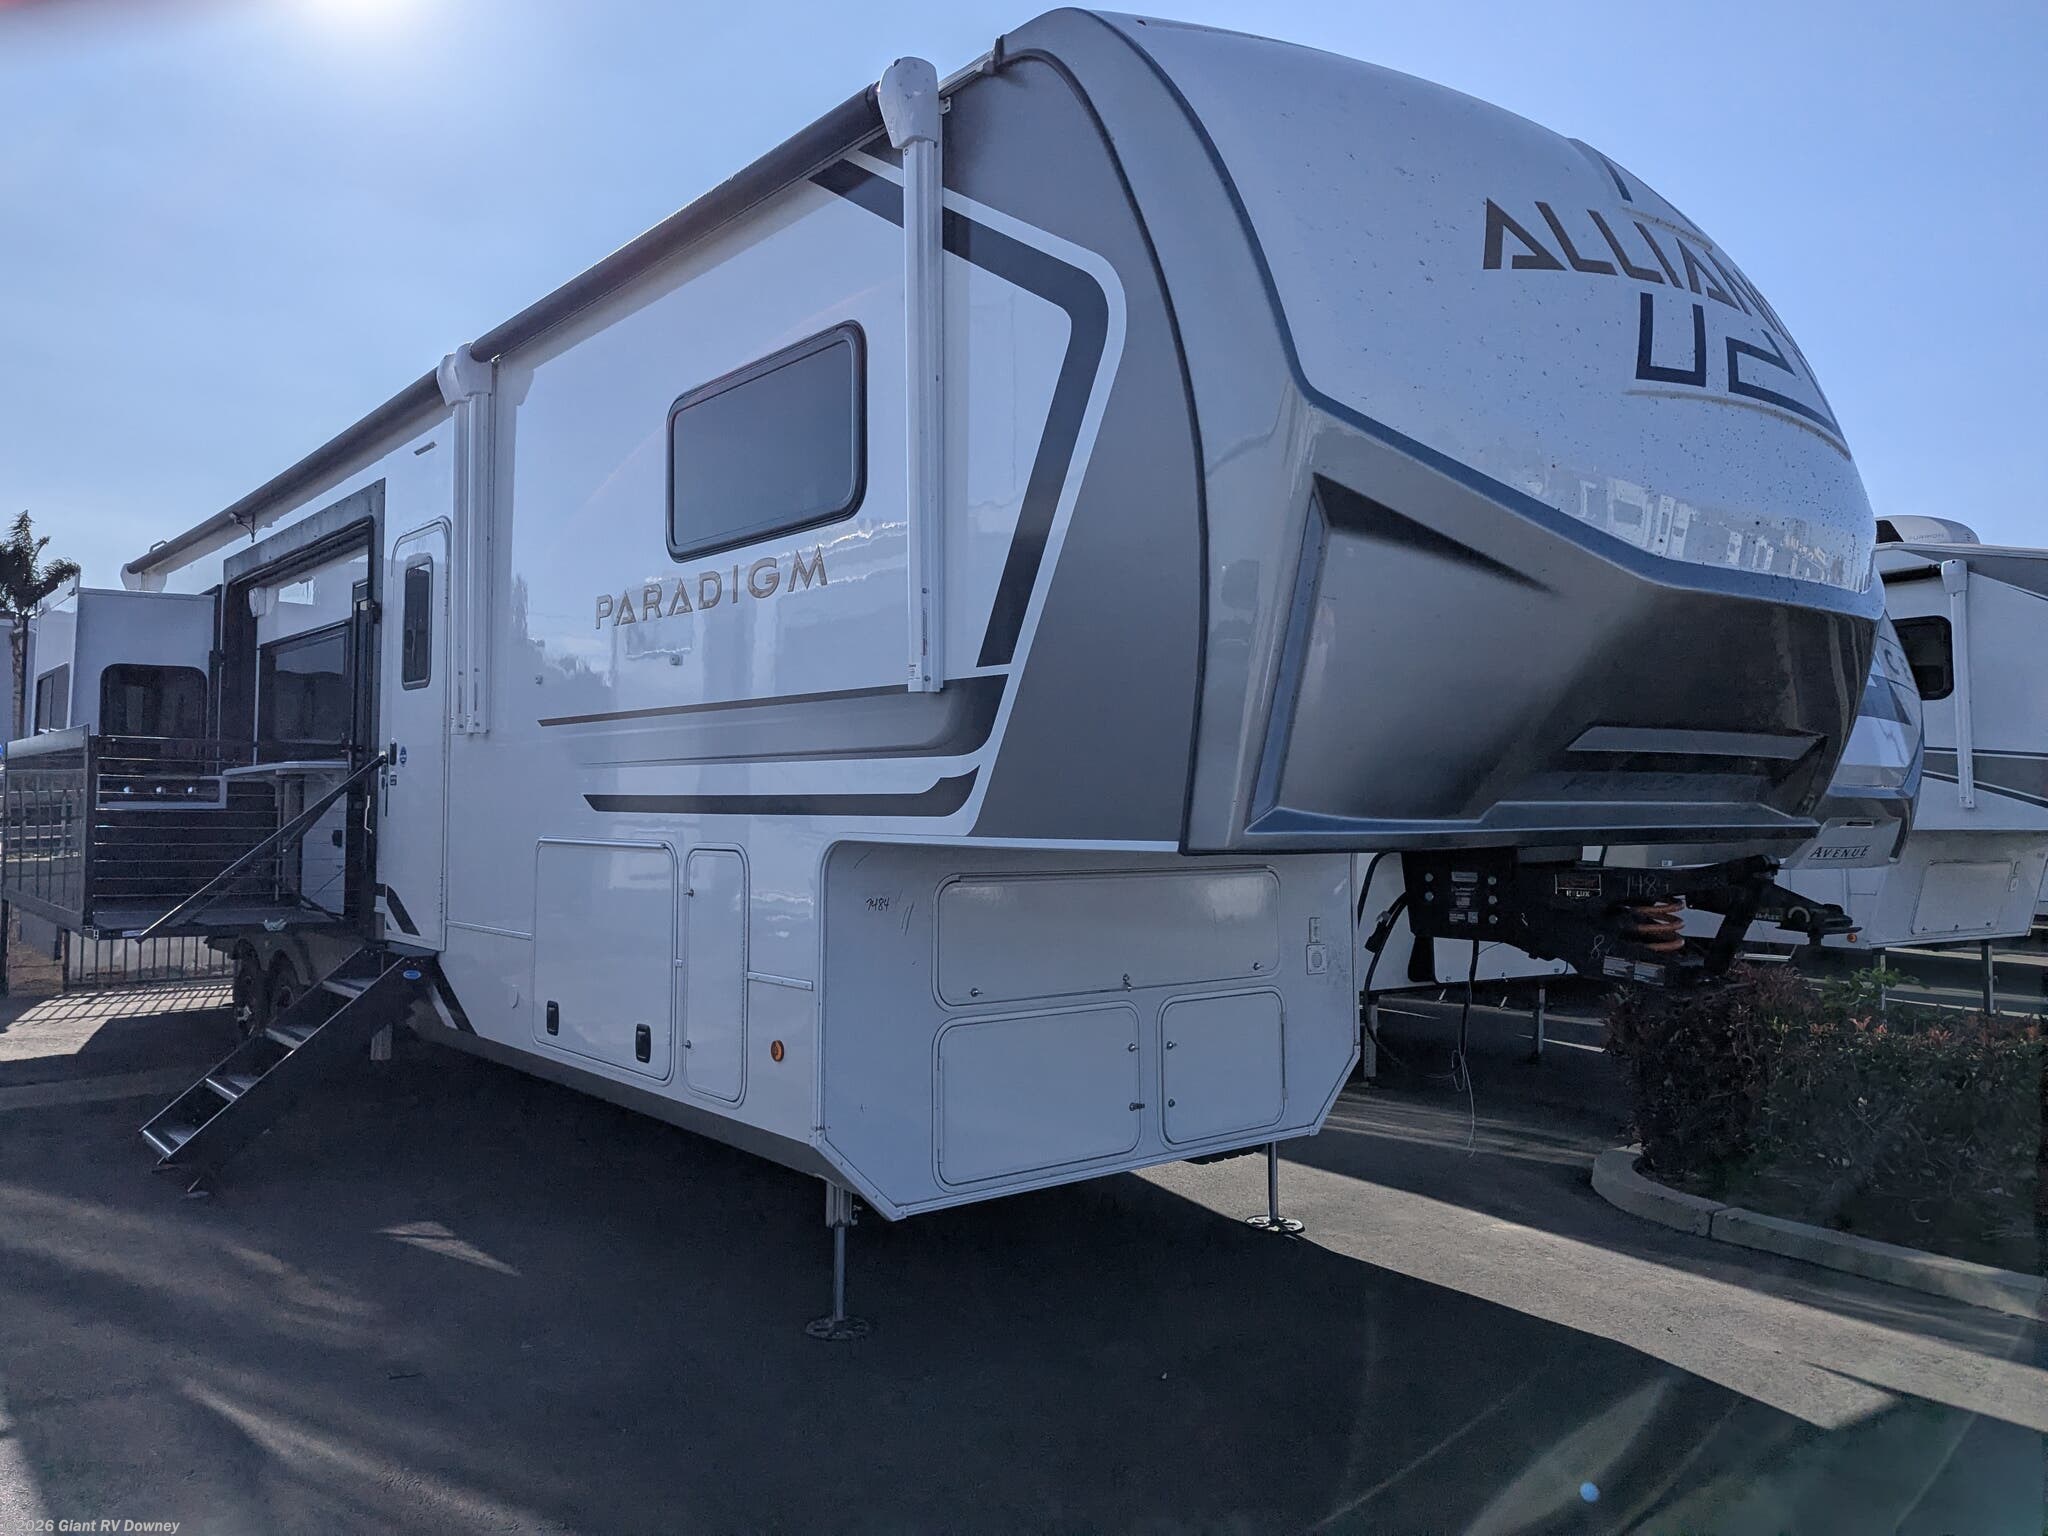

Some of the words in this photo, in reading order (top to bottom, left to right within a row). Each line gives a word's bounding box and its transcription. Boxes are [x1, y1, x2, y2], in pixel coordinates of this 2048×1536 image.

[1483, 198, 1786, 336] ALLIAN
[595, 545, 828, 630] PARADIGM
[1809, 845, 1871, 858] AVENUE
